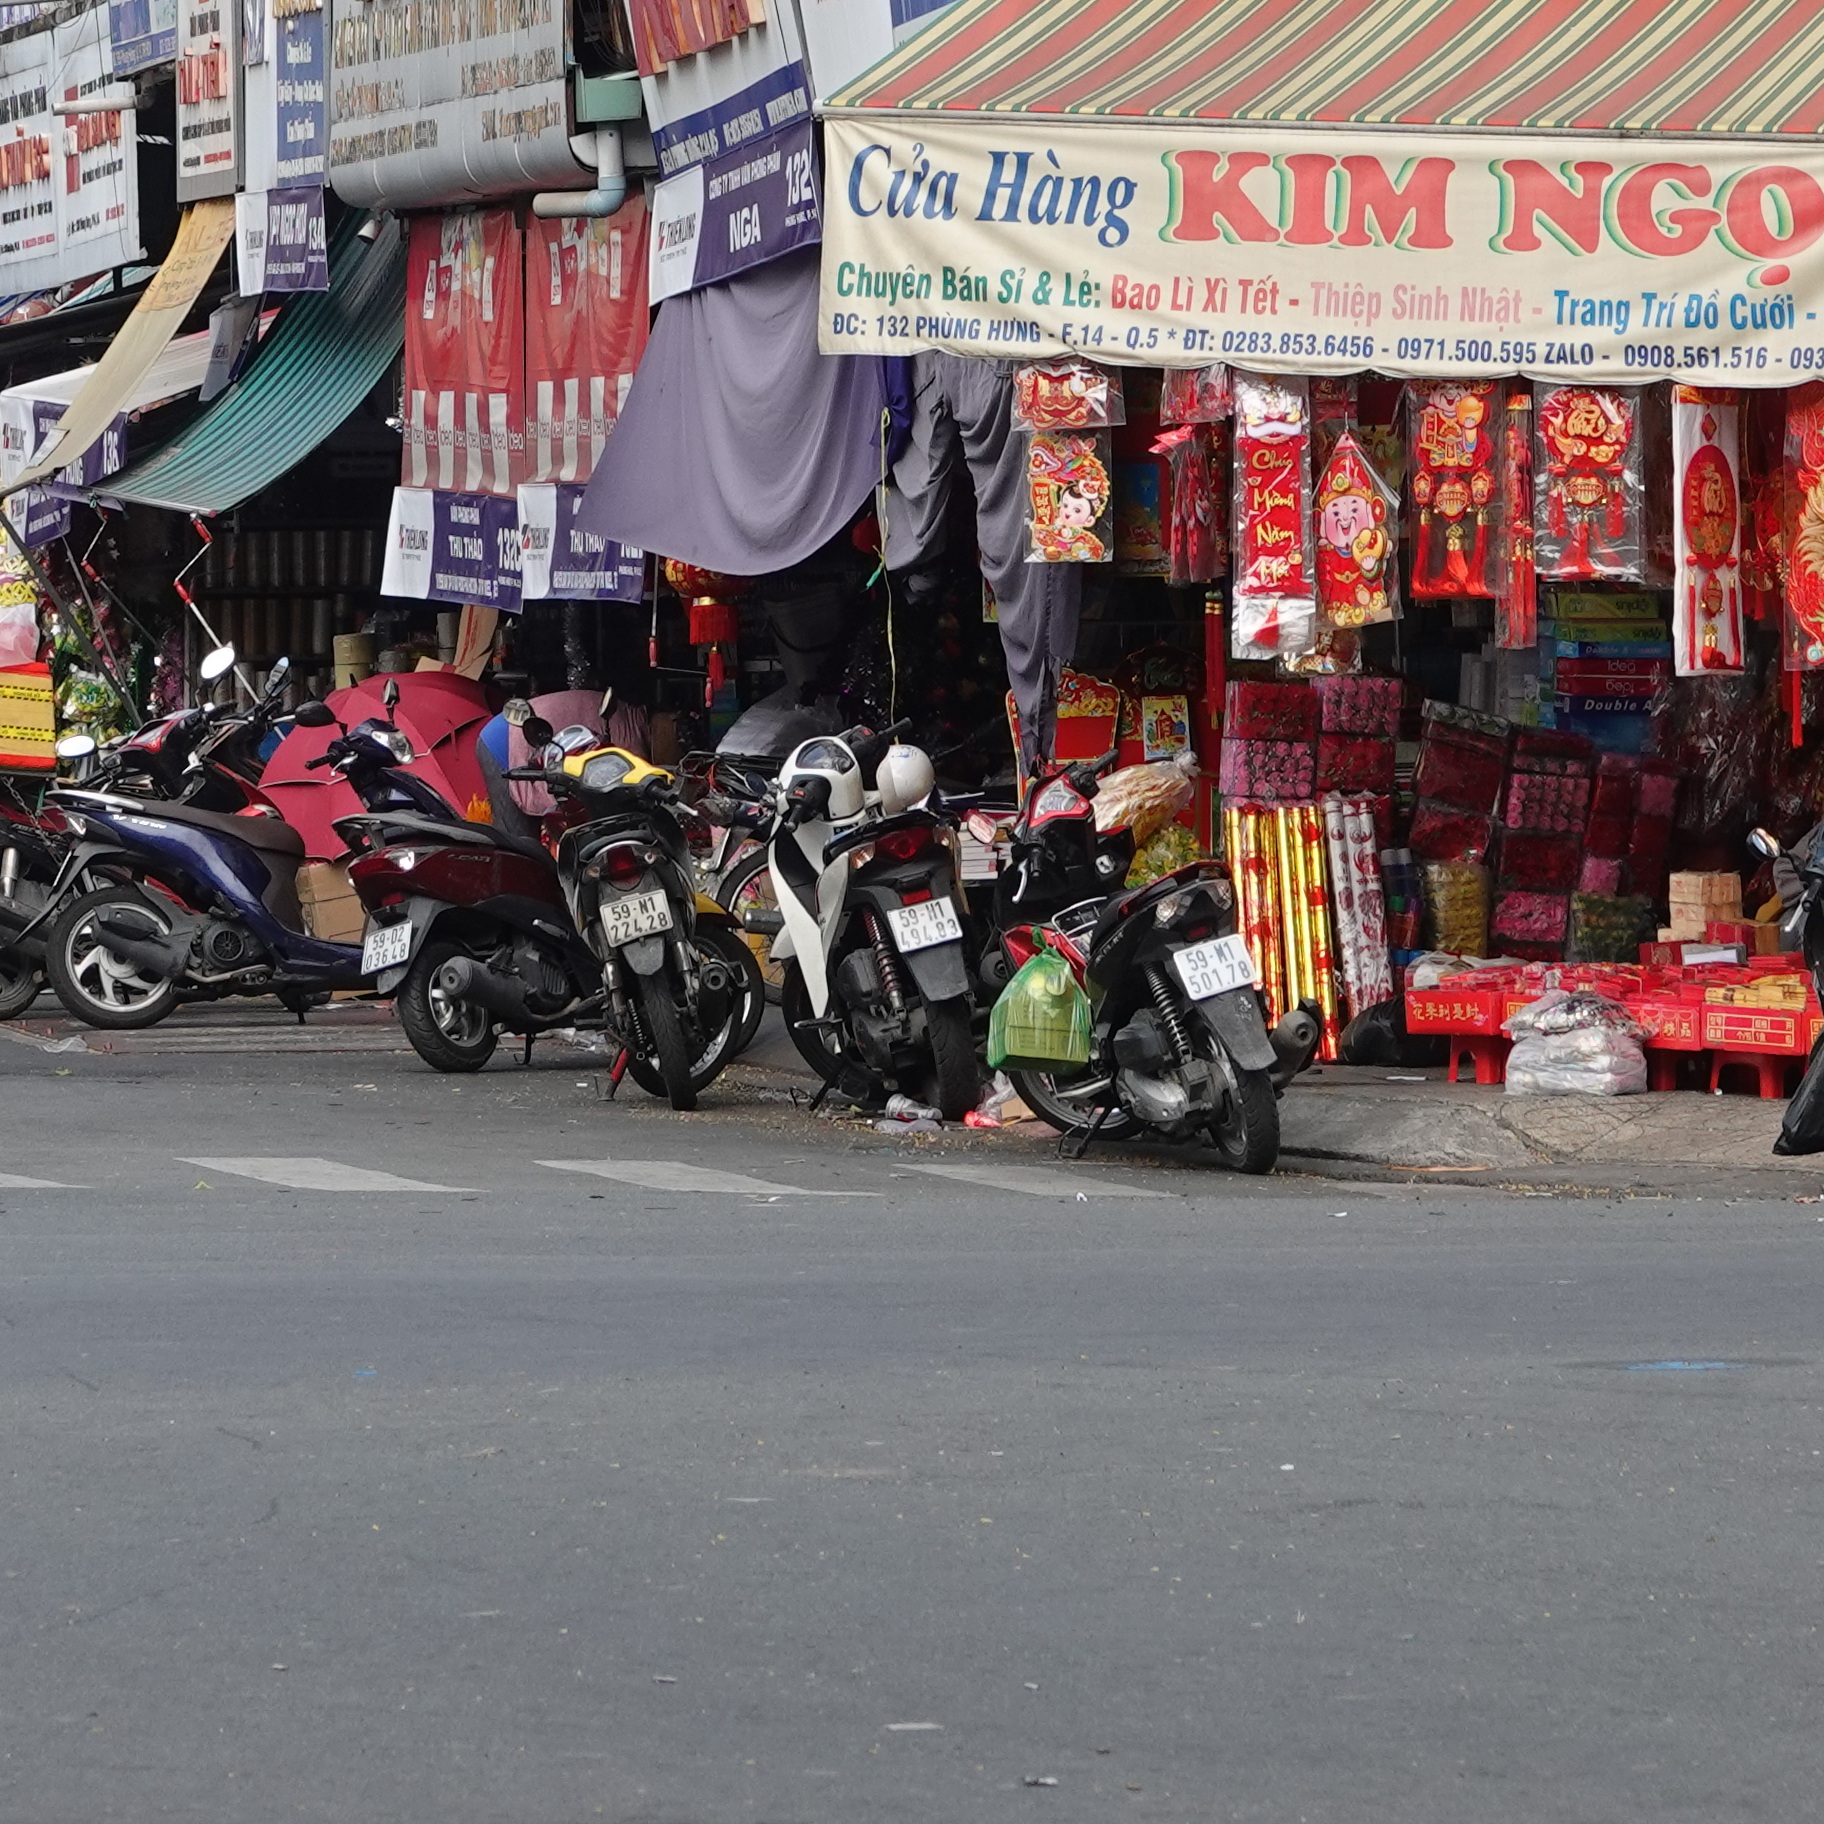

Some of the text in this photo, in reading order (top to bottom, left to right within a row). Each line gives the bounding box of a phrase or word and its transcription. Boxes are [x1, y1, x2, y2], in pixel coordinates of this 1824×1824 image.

[729, 203, 762, 253] NGA
[785, 148, 814, 207] 132
[847, 142, 959, 219] Cửa
[974, 148, 1138, 247] Hàng
[1159, 149, 1457, 252] KIM
[836, 261, 931, 306] Chuyên
[942, 265, 989, 303] Bán
[1111, 274, 1161, 312] Bao
[1171, 275, 1195, 313] Lì
[1203, 277, 1229, 315] Xì
[1239, 273, 1279, 316] Tết
[1311, 281, 1382, 327] Thiệp
[1392, 283, 1449, 324] Sinh
[1460, 285, 1523, 332] Nhật
[1554, 289, 1631, 333] Trang
[1641, 289, 1676, 328] Trí
[1684, 288, 1720, 330] Đồ
[1730, 290, 1795, 330] Cưới
[832, 316, 868, 337] ĐC:
[876, 315, 910, 338] 132
[915, 312, 982, 341] PHÙNG
[987, 315, 1042, 344] HƯNG
[1125, 327, 1159, 352] Q.5
[1183, 328, 1214, 352] ĐT:
[1221, 329, 1374, 359] 0283.853.6456
[1396, 336, 1537, 365] 0971.500.595
[1544, 343, 1594, 367] ZALO
[1623, 344, 1768, 370] 0908.561.516
[448, 530, 483, 561] THU THẢO
[1257, 521, 1294, 547] Năm
[1584, 699, 1654, 711] Double A
[611, 897, 656, 921] 59-N1
[610, 915, 668, 943] 224.28
[900, 920, 958, 950] 494.83
[366, 944, 406, 970] 036.48
[1189, 961, 1251, 994] 501.78
